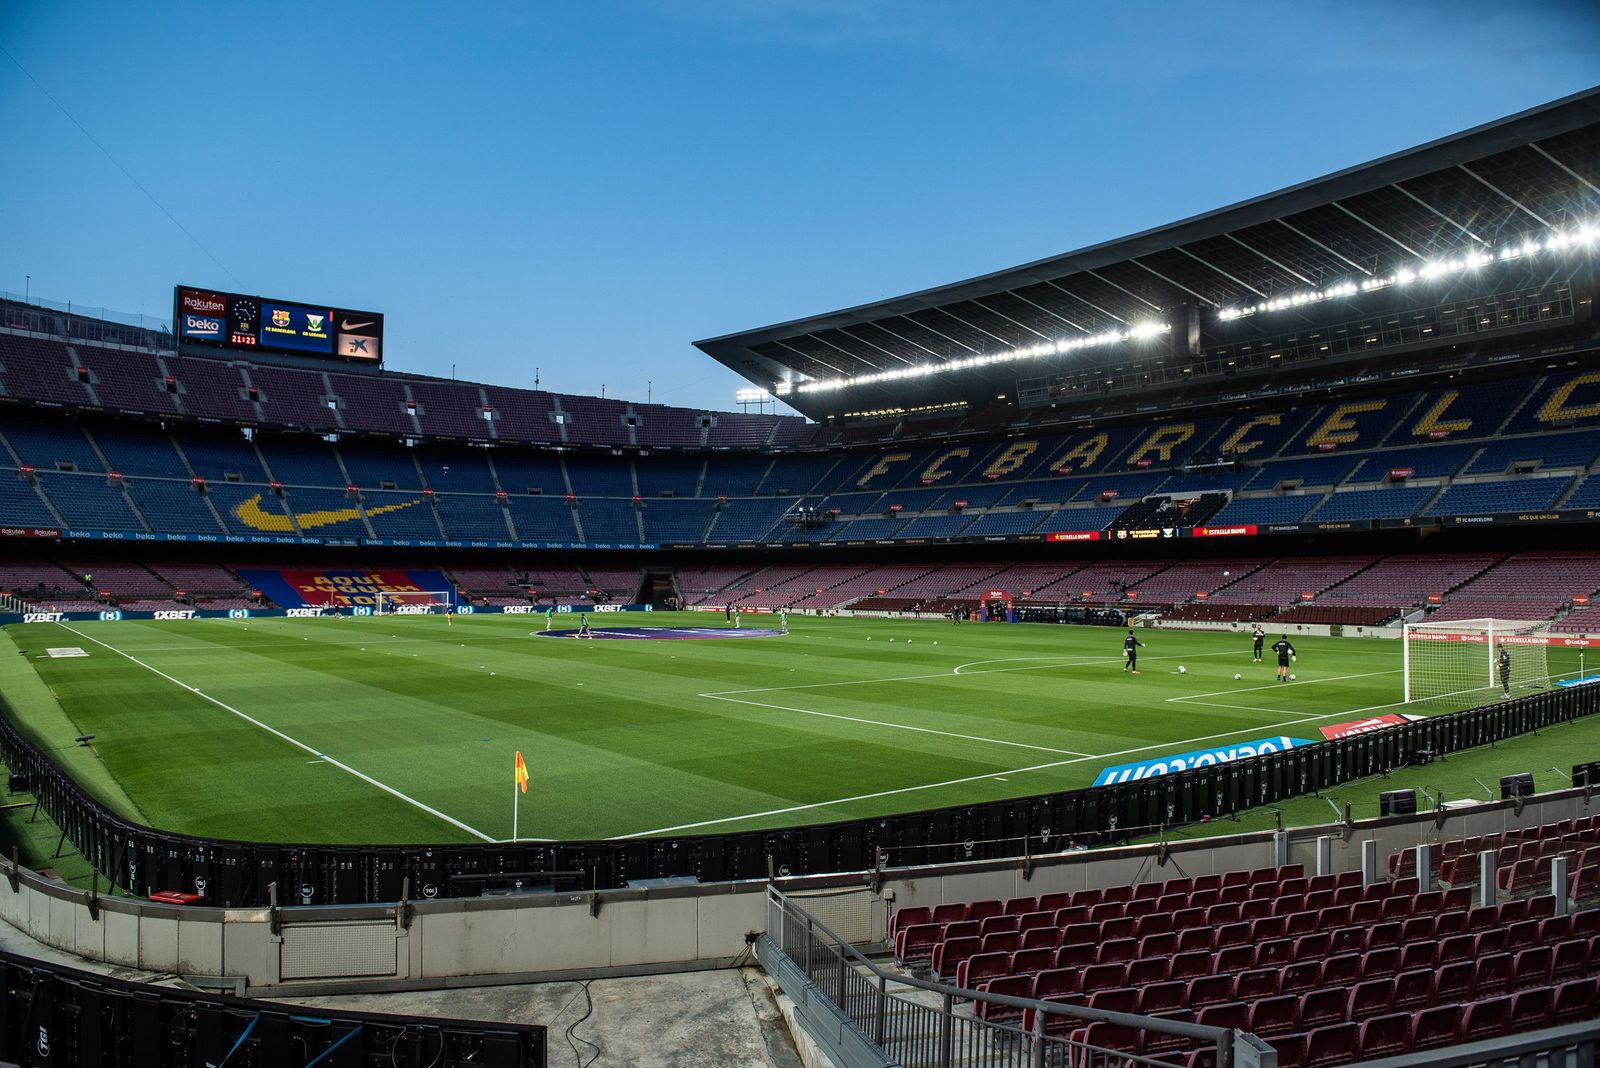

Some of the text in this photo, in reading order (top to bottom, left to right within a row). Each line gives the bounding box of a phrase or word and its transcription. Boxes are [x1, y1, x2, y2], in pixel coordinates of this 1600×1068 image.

[184, 297, 224, 311] Rakuten
[188, 316, 219, 330] beko
[232, 335, 256, 345] 21:23
[40, 1026, 48, 1050] TGI
